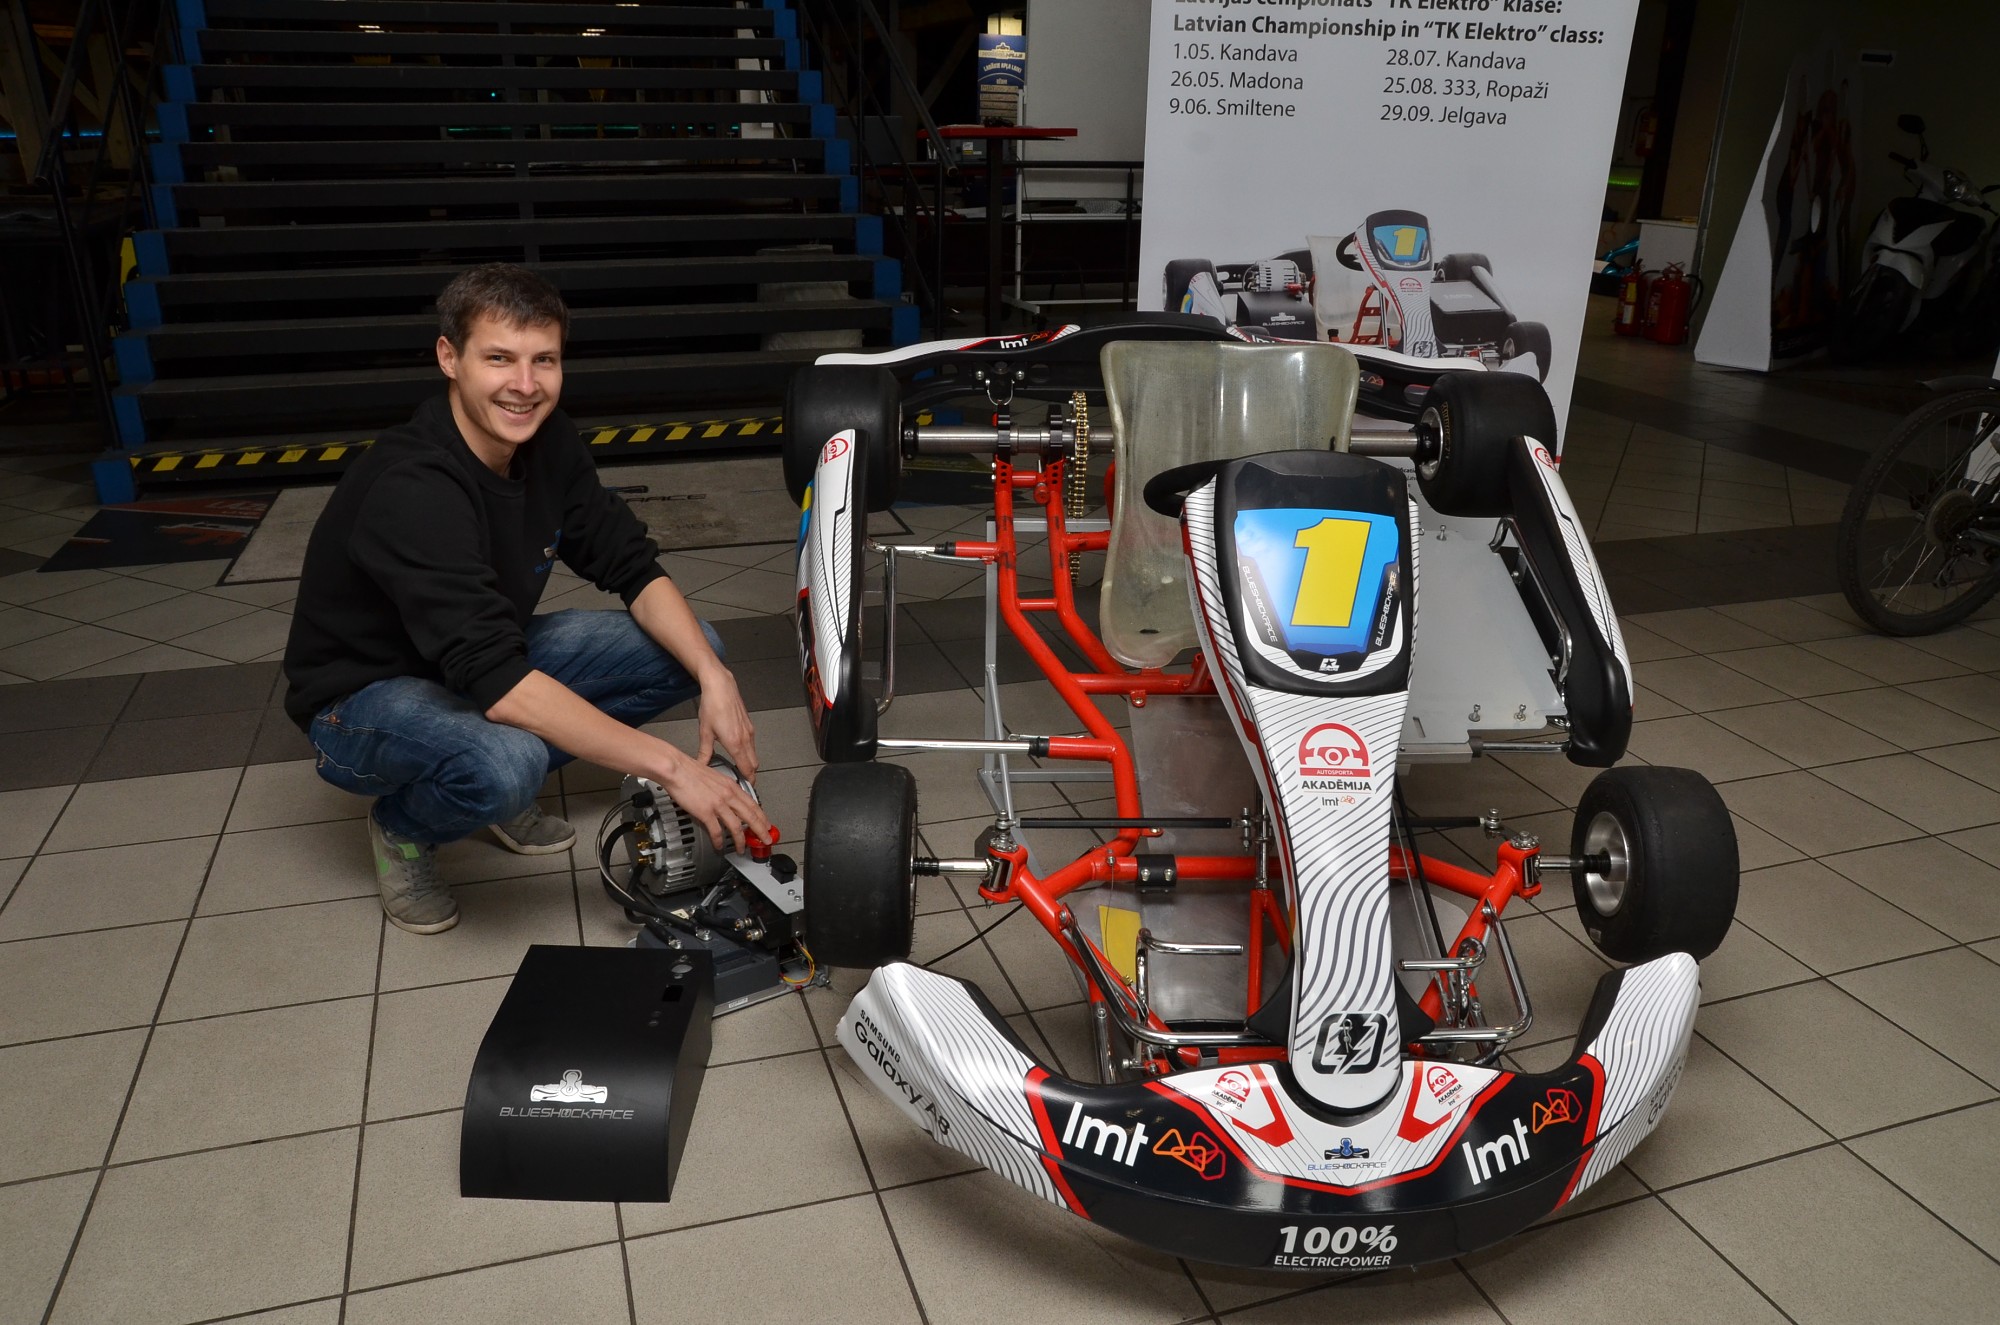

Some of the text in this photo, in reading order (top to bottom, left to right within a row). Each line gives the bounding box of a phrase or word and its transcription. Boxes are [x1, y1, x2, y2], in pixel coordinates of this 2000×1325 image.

[1418, 0, 1498, 11] Elektro
[1503, 0, 1563, 13] klase:
[1174, 14, 1604, 44] Latvian Championship in “TK Elektro” class:
[1174, 43, 1298, 62] 1.05. Kandava
[1386, 49, 1526, 70] 28.07. Kandava
[1170, 70, 1304, 90] 26.05. Madona
[1383, 77, 1549, 102] 25.08. 333, Ropaži
[1169, 97, 1296, 117] 9.06. Smiltene
[1380, 104, 1508, 128] 29.09. Jelgava
[1394, 228, 1418, 256] 1
[1000, 337, 1029, 349] lmt
[1289, 516, 1373, 628] 1
[1242, 565, 1279, 643] BLUESHOCKRACE
[1375, 571, 1398, 647] BLUESHOCKRACE
[1301, 779, 1372, 791] AKADĒMIJA
[1322, 796, 1339, 807] lmt
[859, 1009, 901, 1063] SAMSUNG
[854, 1022, 951, 1136] Galaxy A8
[499, 1107, 635, 1120] BLUESHOCKRACE
[1061, 1101, 1150, 1168] lmt
[1461, 1117, 1532, 1185] lmt
[1307, 1161, 1388, 1171] BLUESHOCKRACE
[1279, 1225, 1398, 1254] 100%
[1274, 1254, 1391, 1267] ELECTRICPOWER
